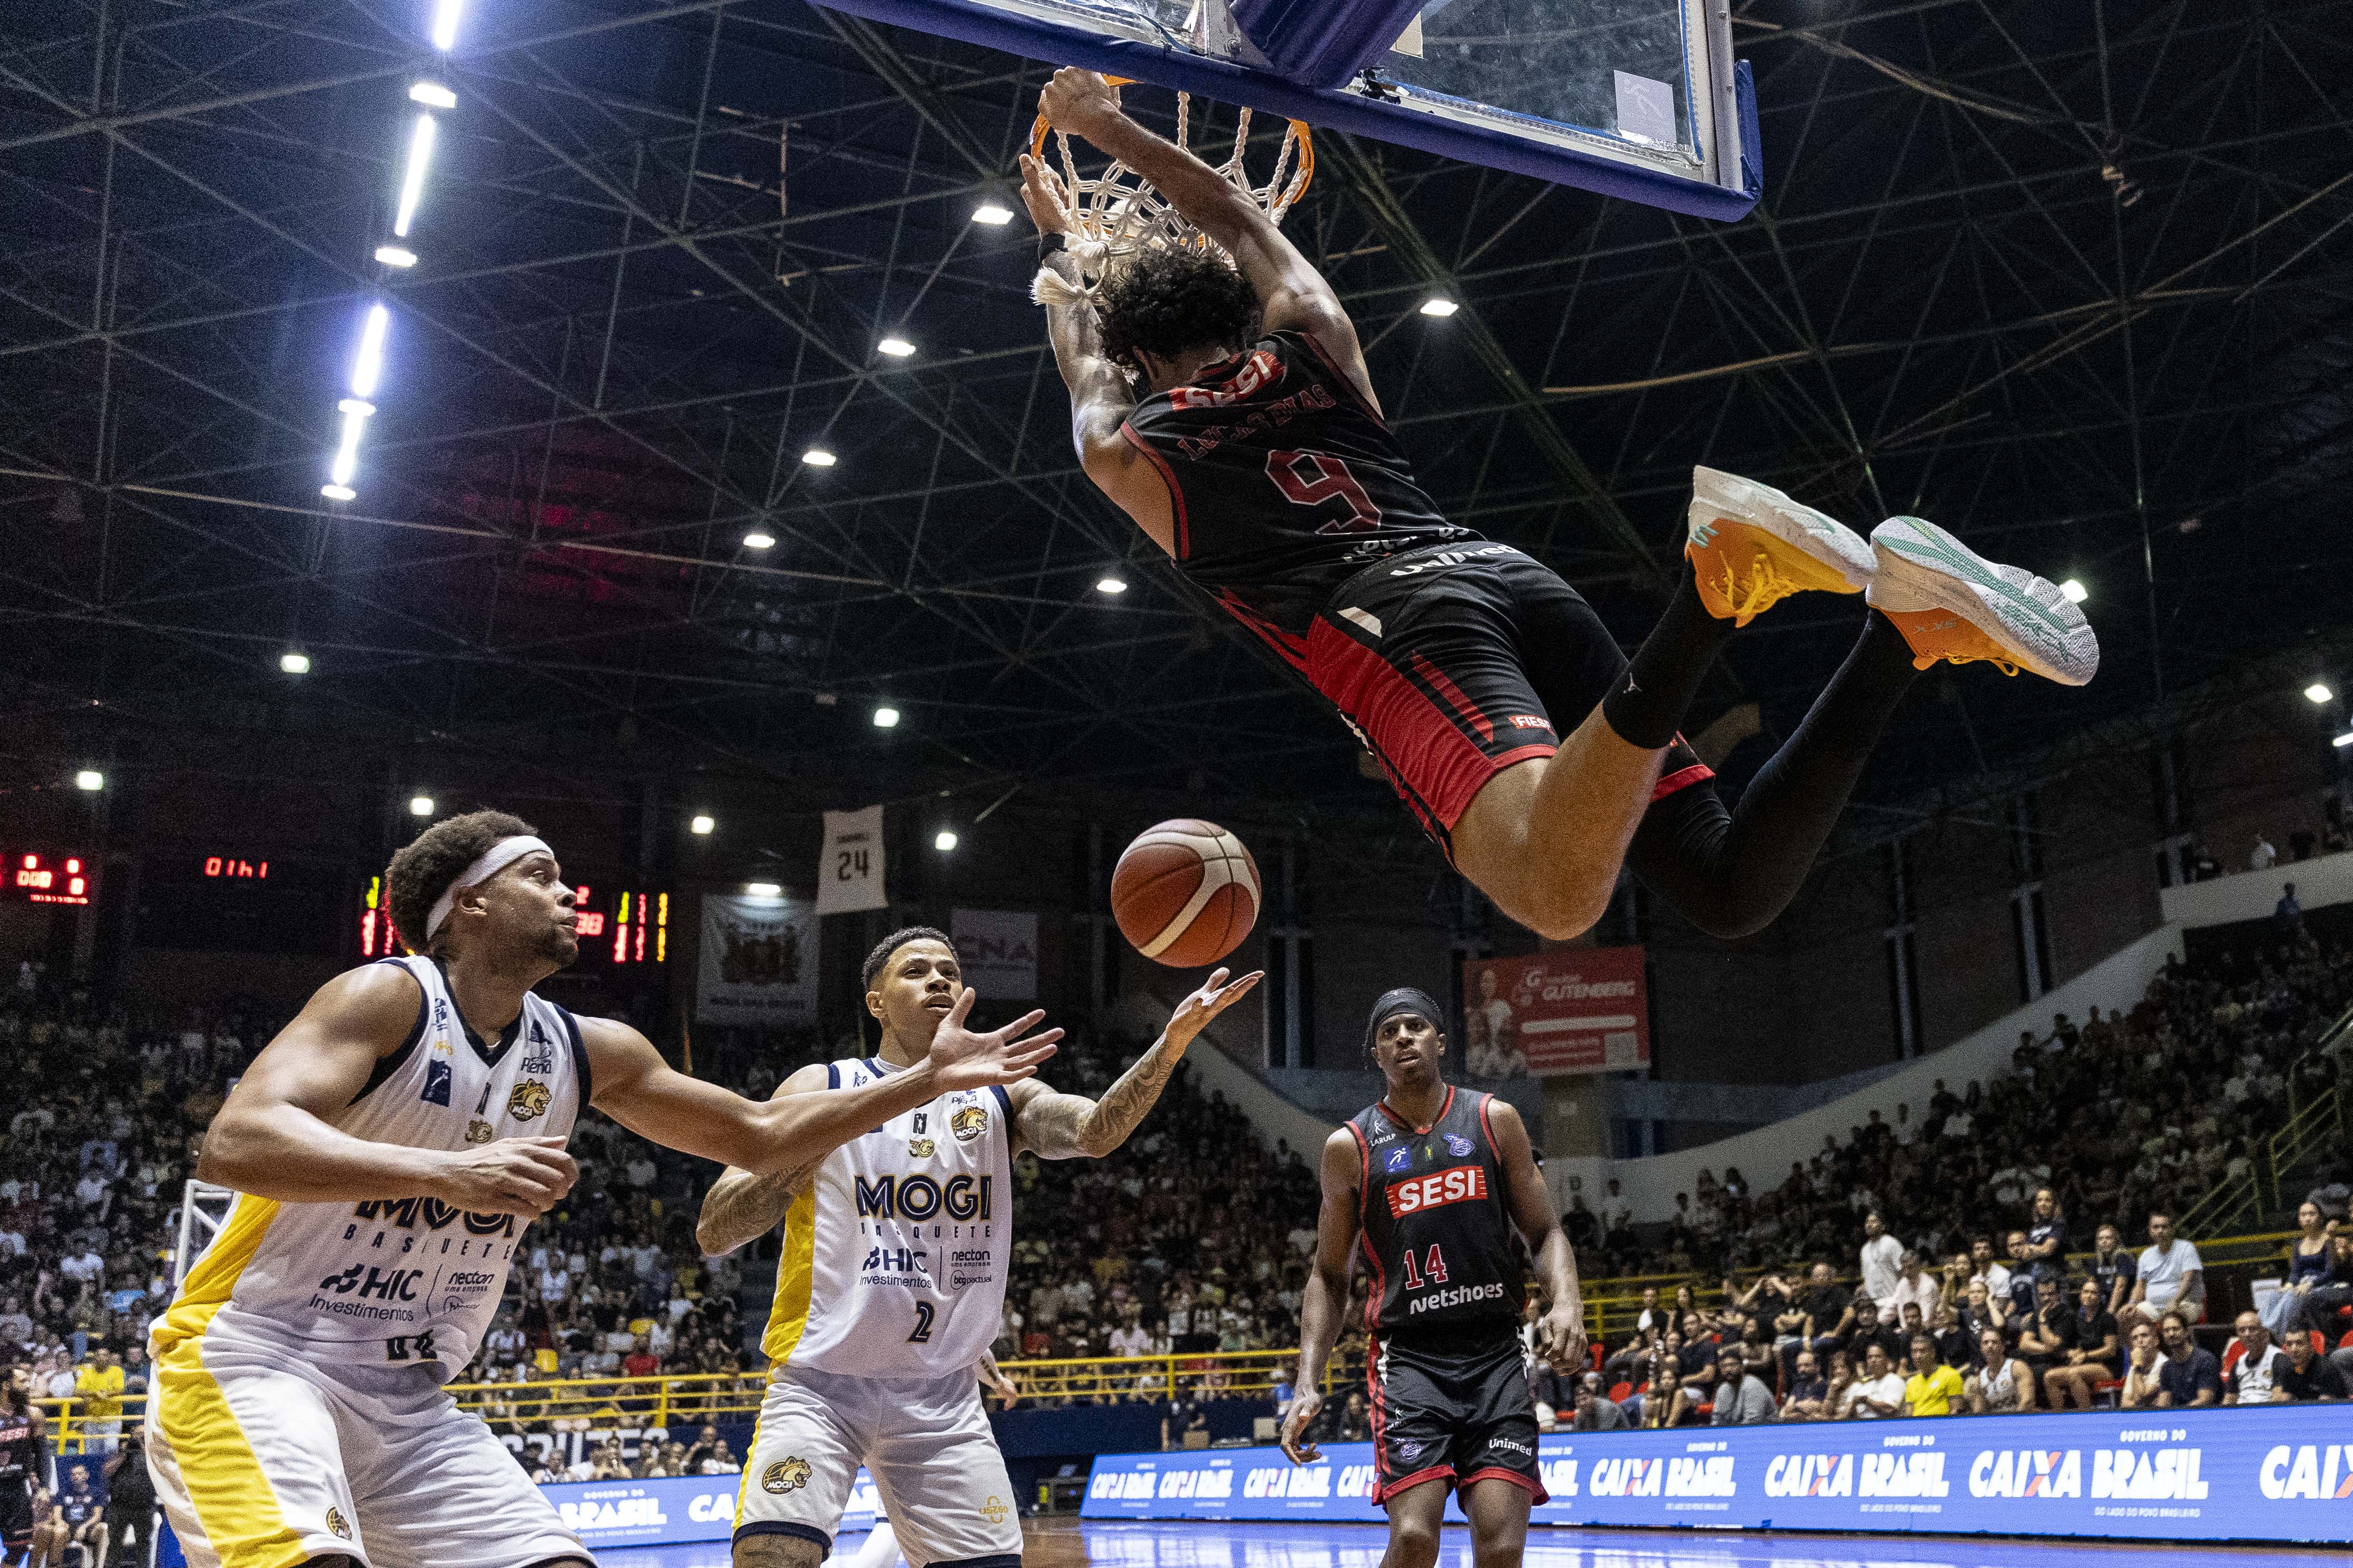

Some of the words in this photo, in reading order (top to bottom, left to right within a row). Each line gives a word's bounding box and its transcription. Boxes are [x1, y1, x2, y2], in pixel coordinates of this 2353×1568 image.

[1265, 448, 1383, 535] 9
[838, 850, 869, 881] 24
[1542, 981, 1636, 1000] GUTENBERG
[956, 1127, 977, 1137] MOGI
[854, 1173, 993, 1223] MOGI
[1399, 1170, 1476, 1211] SESI
[883, 1247, 928, 1274] HIC
[951, 1248, 991, 1262] necton
[1404, 1244, 1448, 1290] 14
[358, 1264, 424, 1301] HIC
[448, 1270, 495, 1285] necton
[859, 1275, 932, 1289] Investimentos
[308, 1293, 414, 1322] Investimentos
[1410, 1283, 1504, 1315] netshoes
[905, 1299, 936, 1344] 2
[1489, 1438, 1532, 1456] Unimed
[2120, 1429, 2168, 1443] GOVERNO
[2171, 1429, 2187, 1442] DO
[766, 1481, 793, 1489] MOGI
[1589, 1458, 1663, 1497] CAIXA
[1664, 1456, 1737, 1497] BRASIL
[1764, 1454, 1854, 1497] CAIXA
[1858, 1452, 1950, 1497] BRASIL
[1968, 1449, 2082, 1498] CAIXA
[2090, 1448, 2209, 1500] BRASIL
[559, 1497, 668, 1531] BRASIL
[2094, 1506, 2106, 1516] DO
[2139, 1507, 2159, 1517] POVO
[2160, 1507, 2201, 1518] BRASILEIRO
